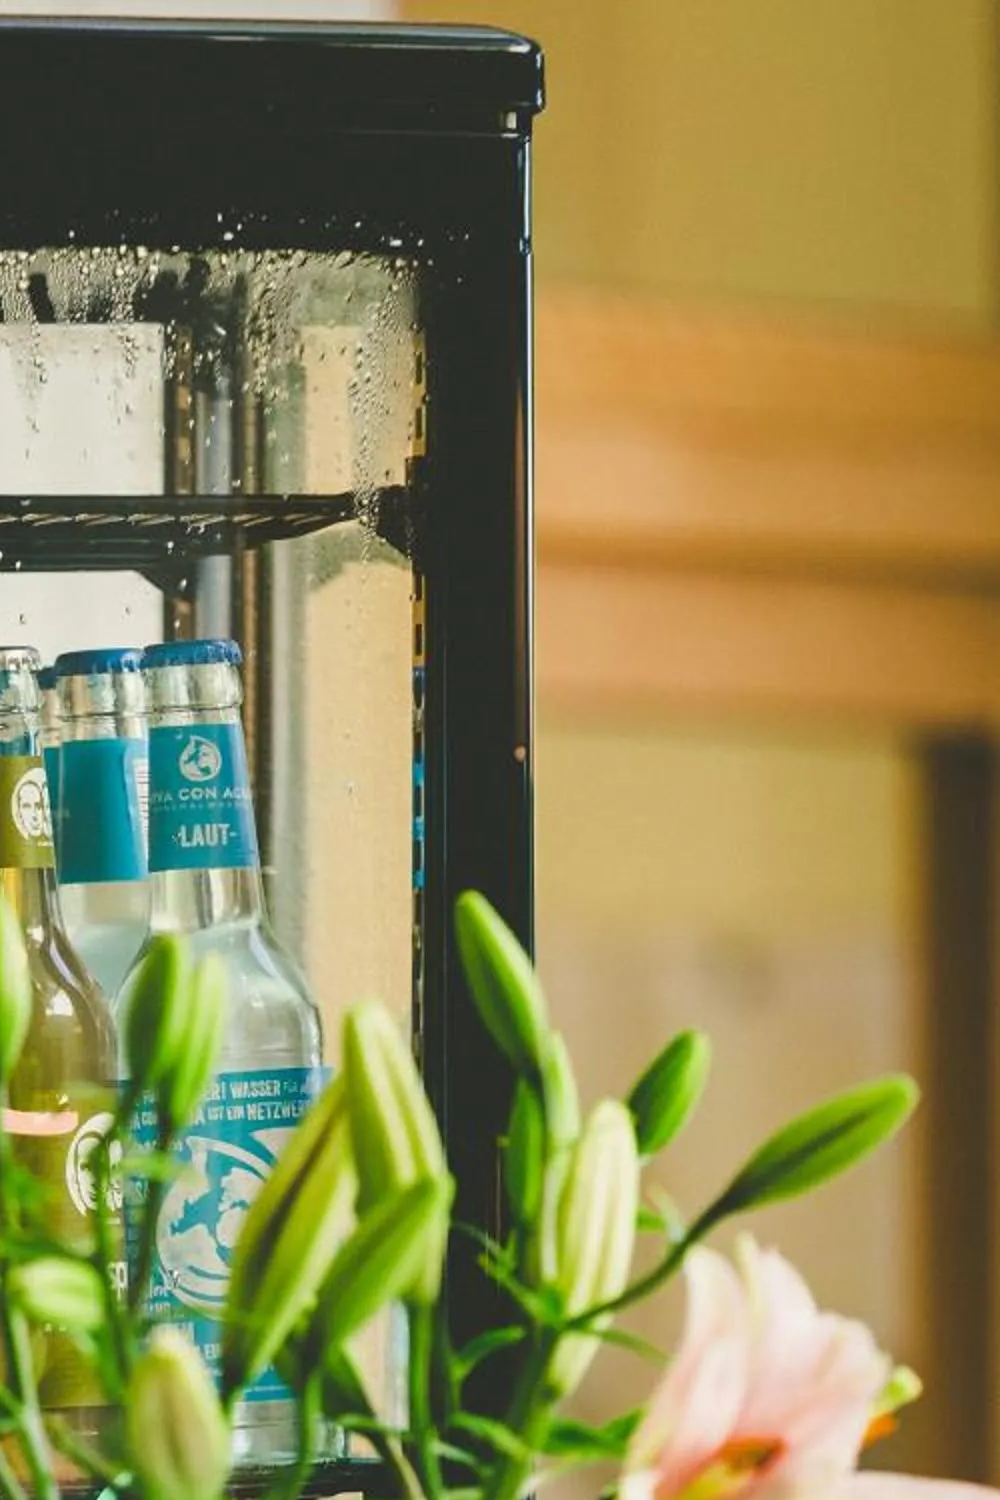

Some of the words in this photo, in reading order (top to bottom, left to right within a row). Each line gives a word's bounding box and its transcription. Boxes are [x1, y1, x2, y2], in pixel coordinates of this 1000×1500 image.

[178, 787, 217, 801] CON
[229, 1079, 281, 1100] WASSER
[226, 1104, 244, 1121] EIN
